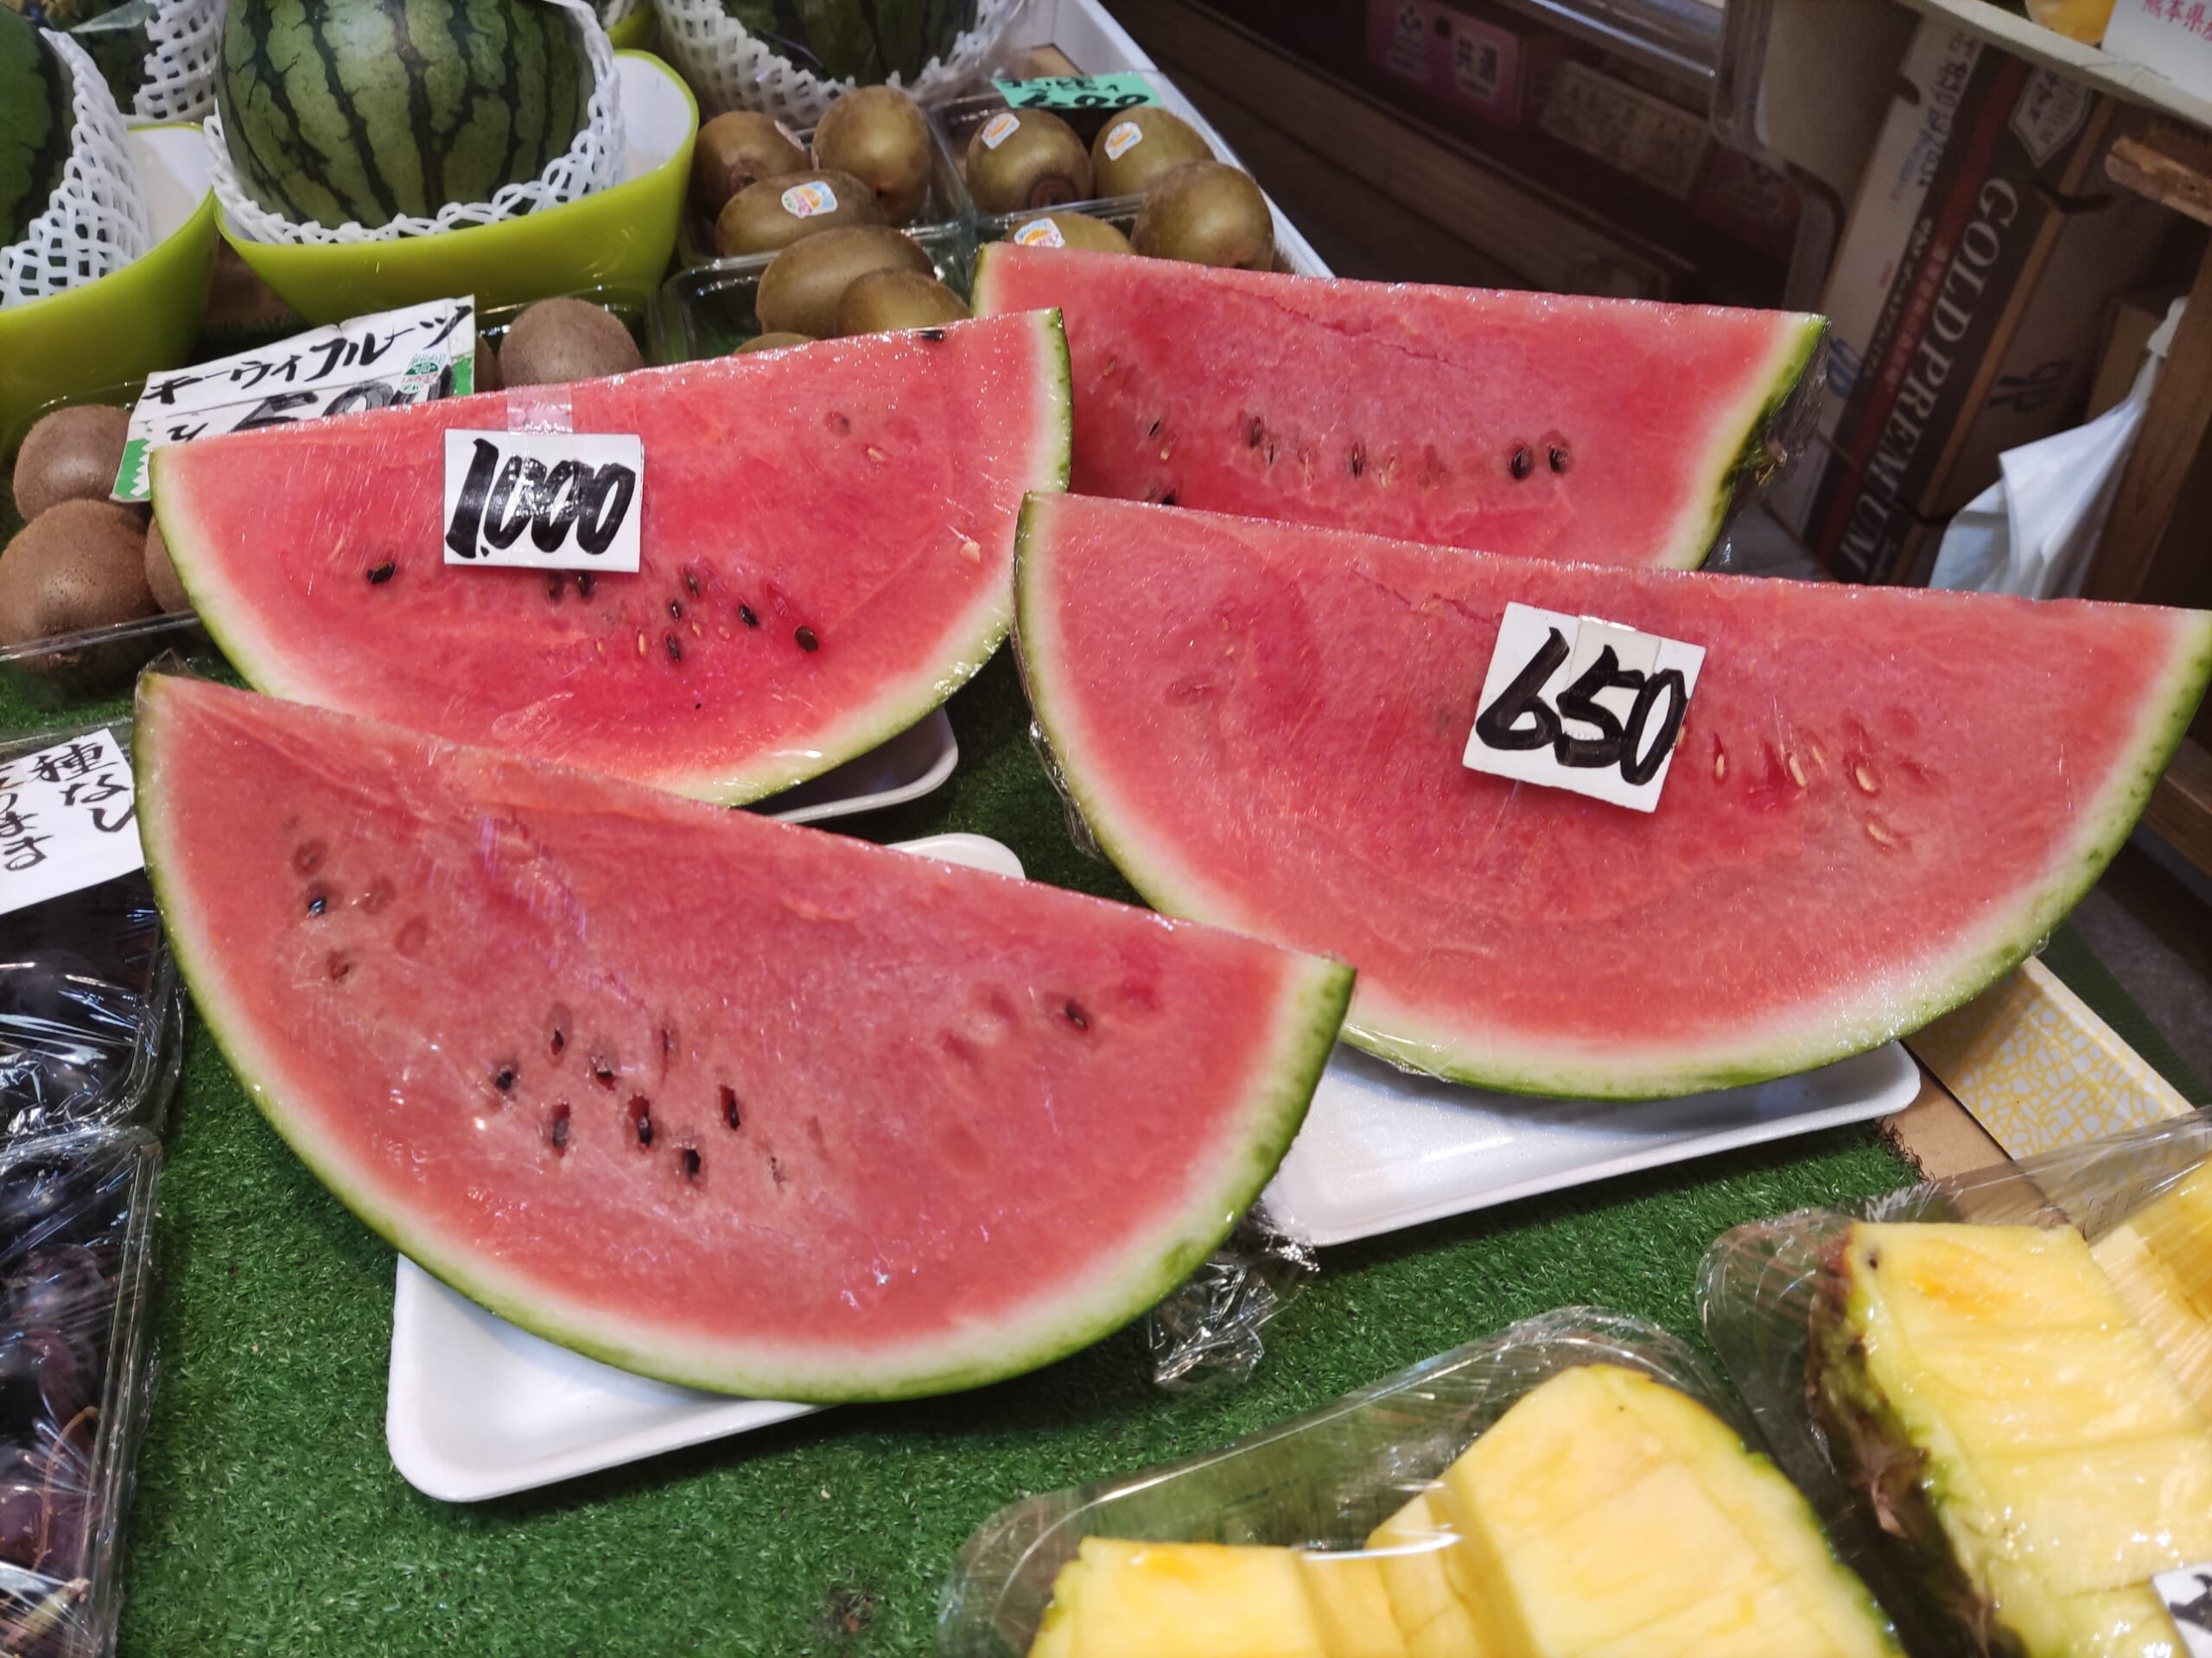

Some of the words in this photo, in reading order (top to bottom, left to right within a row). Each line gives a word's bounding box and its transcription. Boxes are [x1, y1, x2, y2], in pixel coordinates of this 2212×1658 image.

[1931, 176, 2018, 342] GOLD
[1840, 342, 1955, 574] PREMUM
[1476, 627, 1688, 785] 650
